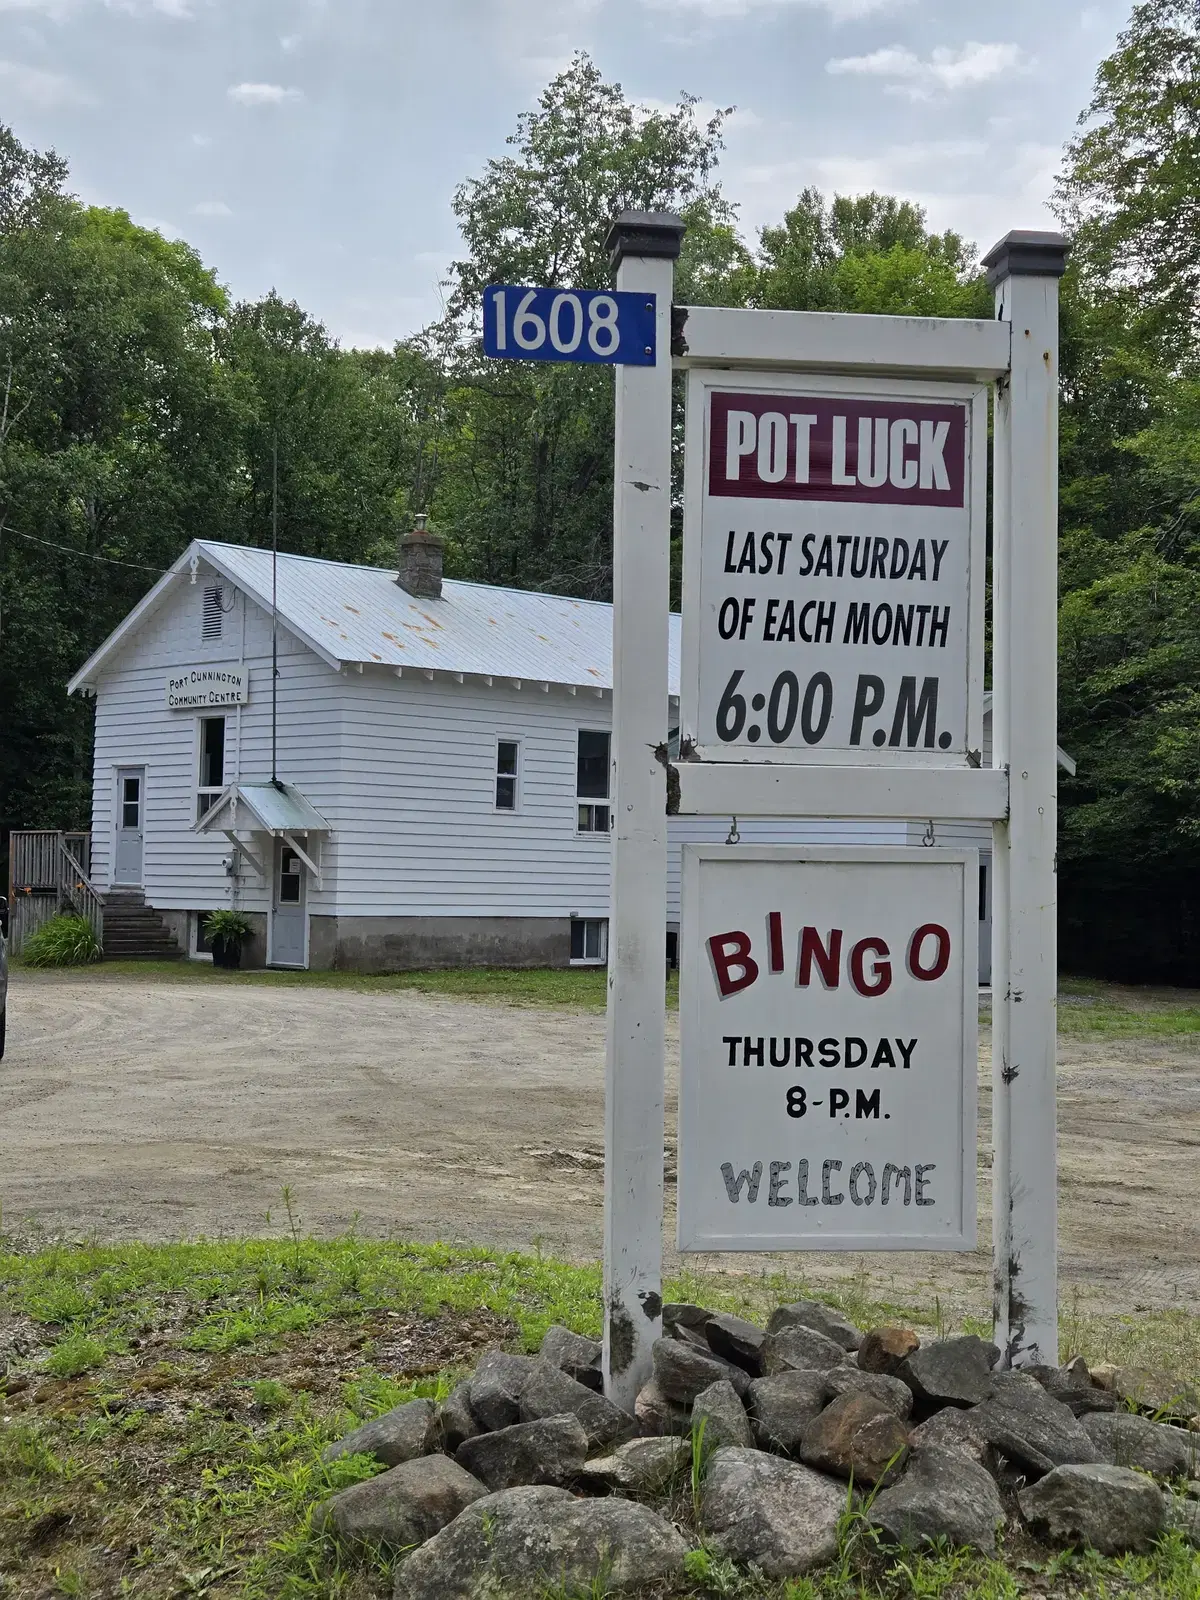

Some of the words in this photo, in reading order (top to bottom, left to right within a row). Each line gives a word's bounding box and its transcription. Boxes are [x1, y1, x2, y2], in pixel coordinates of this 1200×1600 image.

[492, 290, 621, 357] 1608
[725, 410, 818, 485] POT
[831, 415, 951, 491] LUCK
[723, 531, 792, 575] LAST
[799, 533, 949, 582] SATURDAY
[718, 597, 754, 641] OF
[764, 600, 836, 644] EACH
[844, 603, 951, 648] MONTH
[168, 694, 207, 706] COMMUNITY
[208, 691, 242, 703] CENTRE
[169, 676, 189, 692] PORT
[190, 671, 242, 687] CUNNINGTON
[716, 670, 834, 745] 6:00
[849, 675, 953, 750] P.M.
[706, 911, 951, 1001] BINGO
[722, 1036, 918, 1069] THURSDAY
[720, 1159, 937, 1207] WELCOME
